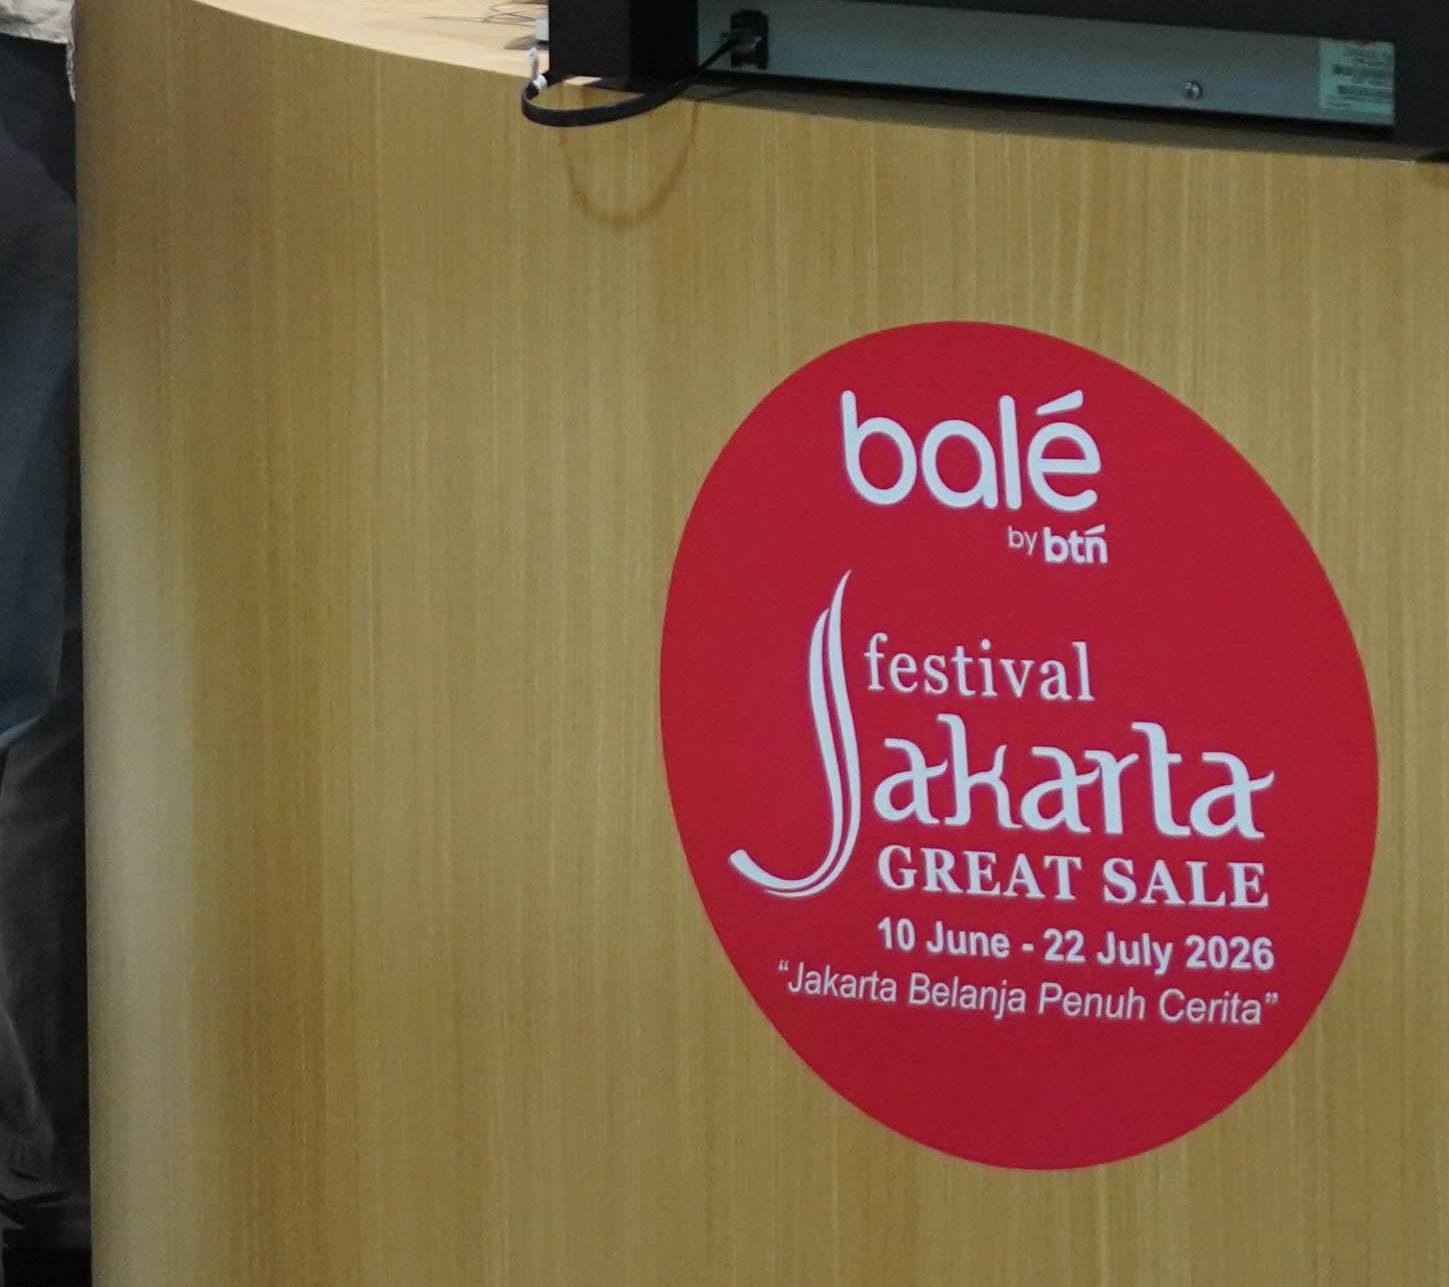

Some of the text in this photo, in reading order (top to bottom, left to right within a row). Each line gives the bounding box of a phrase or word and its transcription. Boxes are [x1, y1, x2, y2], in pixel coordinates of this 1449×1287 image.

[841, 390, 1101, 512] balé
[1007, 525, 1038, 556] by
[864, 632, 1095, 701] festival
[729, 569, 1275, 898] Jakarta
[877, 845, 1269, 909] GREAT SALE
[878, 917, 915, 951] 10
[926, 921, 1011, 959] June
[1043, 928, 1085, 963] 22
[1096, 931, 1173, 975] July
[1185, 935, 1275, 971] 2026
[908, 971, 1026, 1019] Belanja
[1038, 981, 1146, 1020] Penuh
